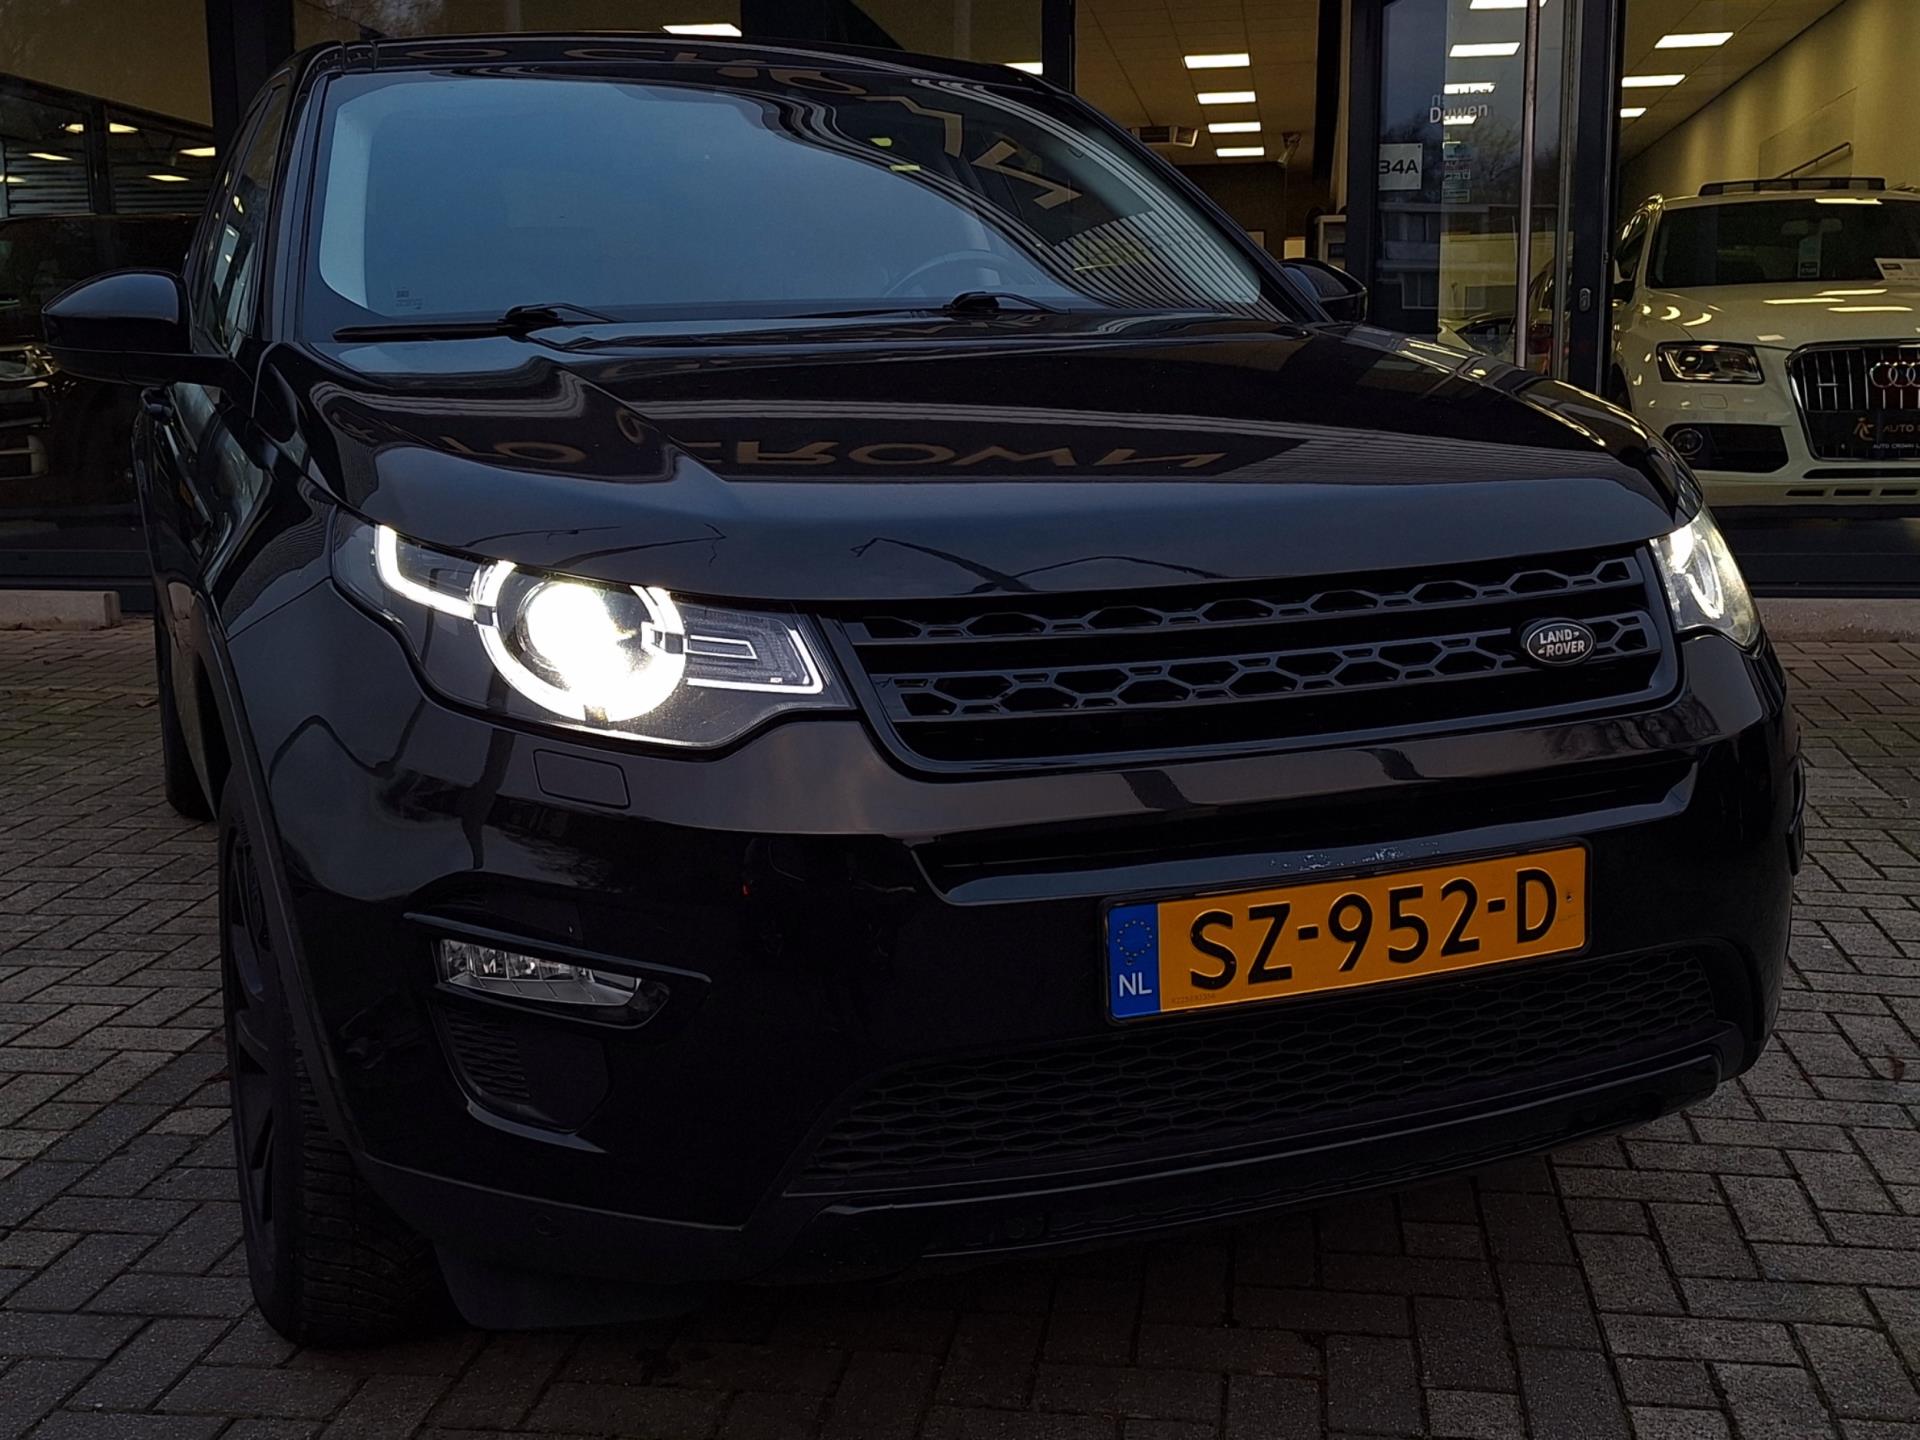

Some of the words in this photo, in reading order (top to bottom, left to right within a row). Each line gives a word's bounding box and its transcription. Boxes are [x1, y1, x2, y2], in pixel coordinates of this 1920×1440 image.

[1539, 628, 1573, 645] LAND
[1545, 639, 1586, 657] ROVER
[1188, 866, 1559, 991] SZ-952-D
[1117, 971, 1153, 998] NL
